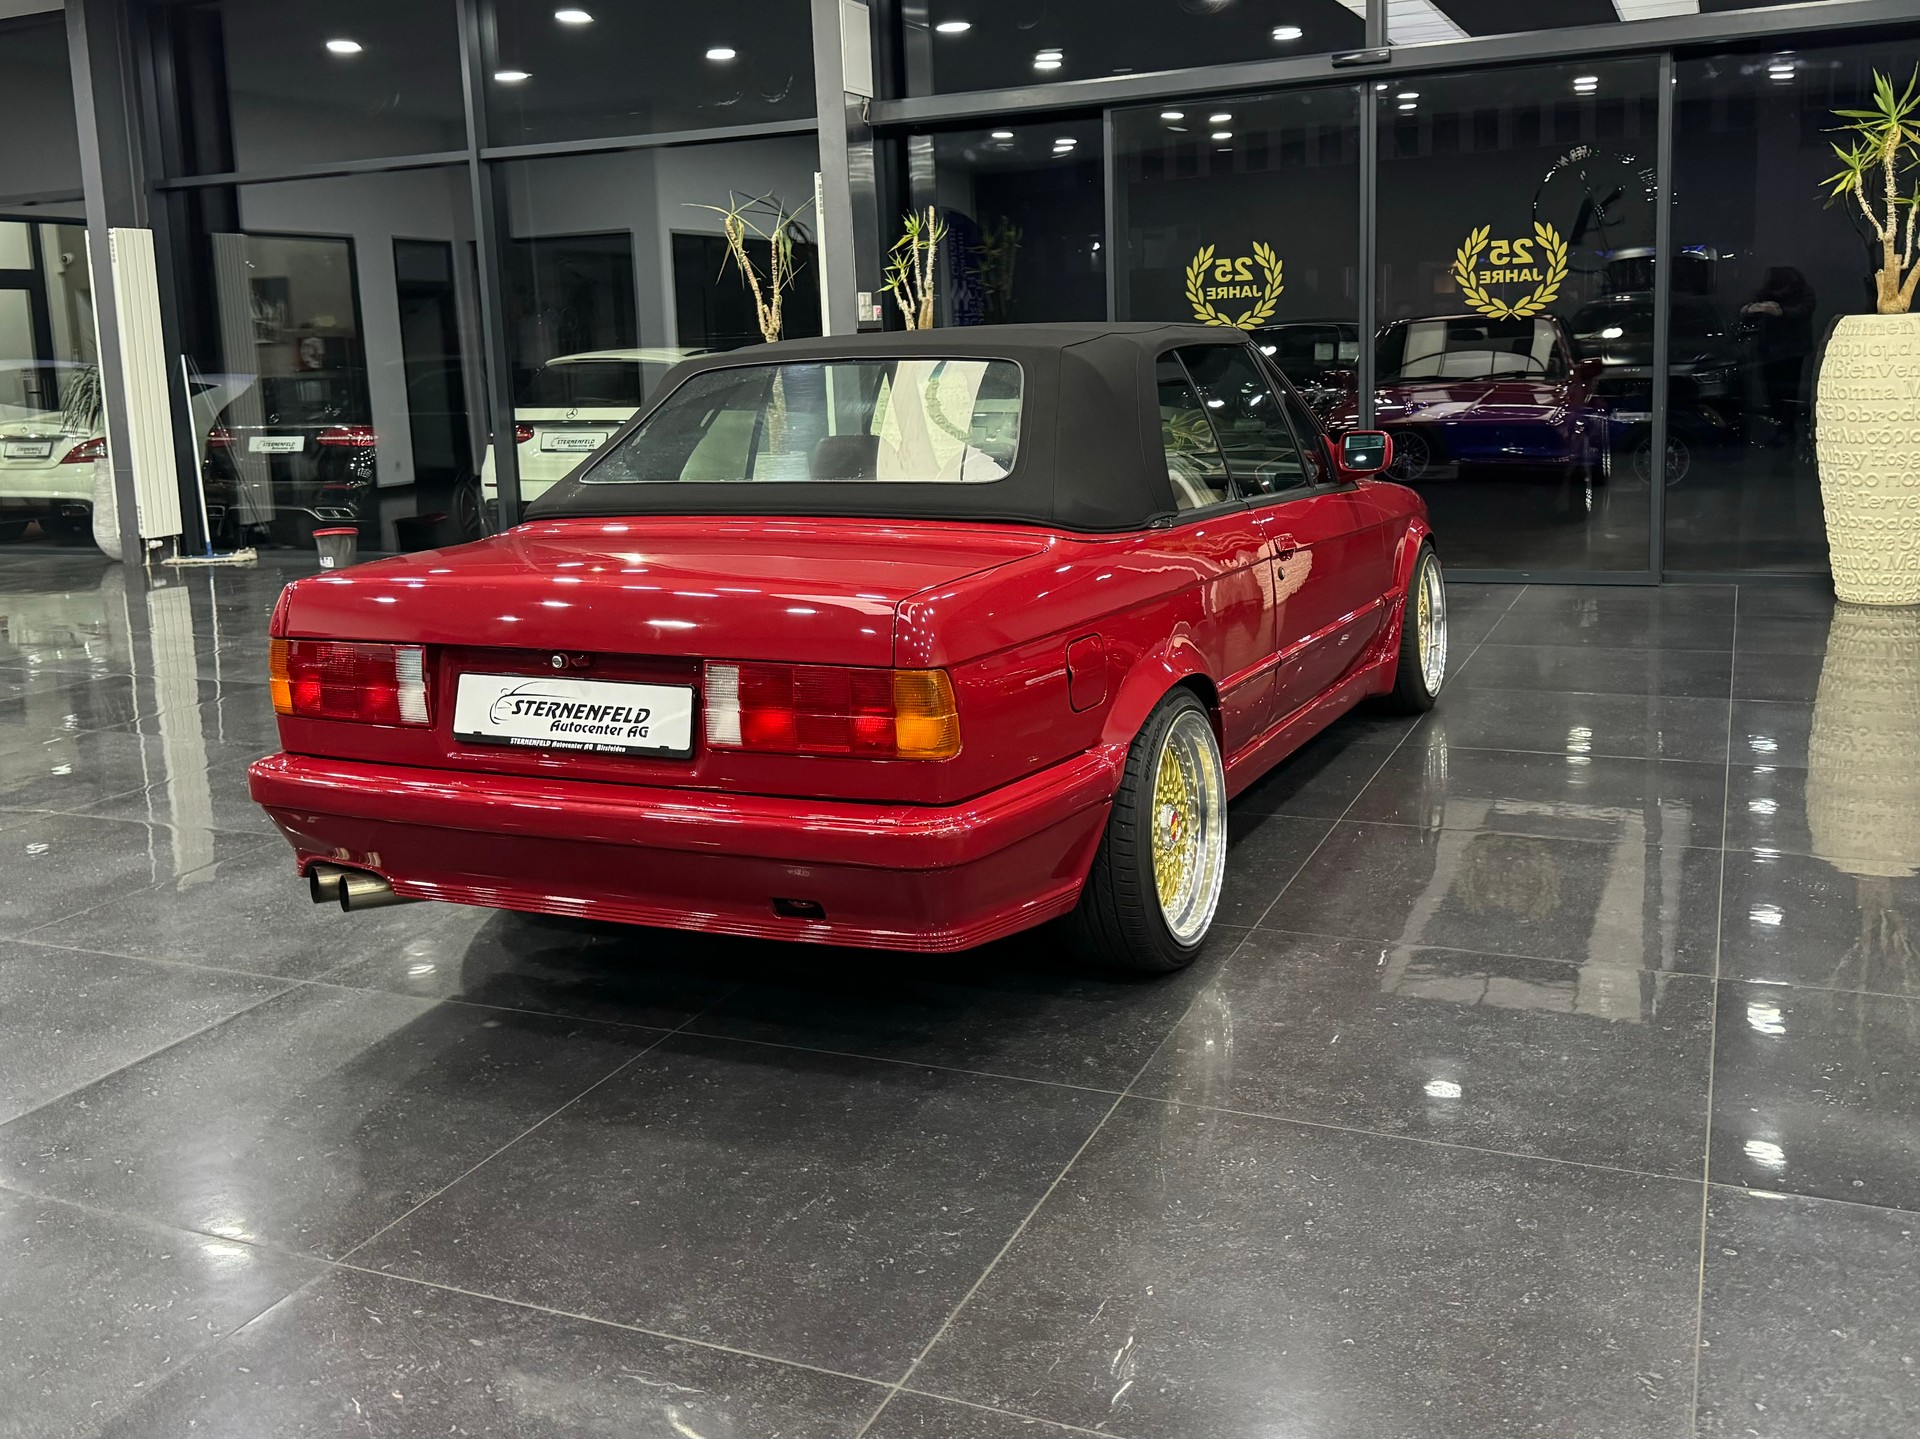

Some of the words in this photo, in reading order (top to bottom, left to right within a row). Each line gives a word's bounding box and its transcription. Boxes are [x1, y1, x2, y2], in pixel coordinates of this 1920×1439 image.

[511, 699, 651, 724] STERNENFELD
[550, 719, 624, 737] Autocenter
[626, 725, 650, 739] AG
[510, 737, 551, 748] STERNENFELD
[551, 740, 583, 750] Autocenter
[583, 742, 594, 751] AG
